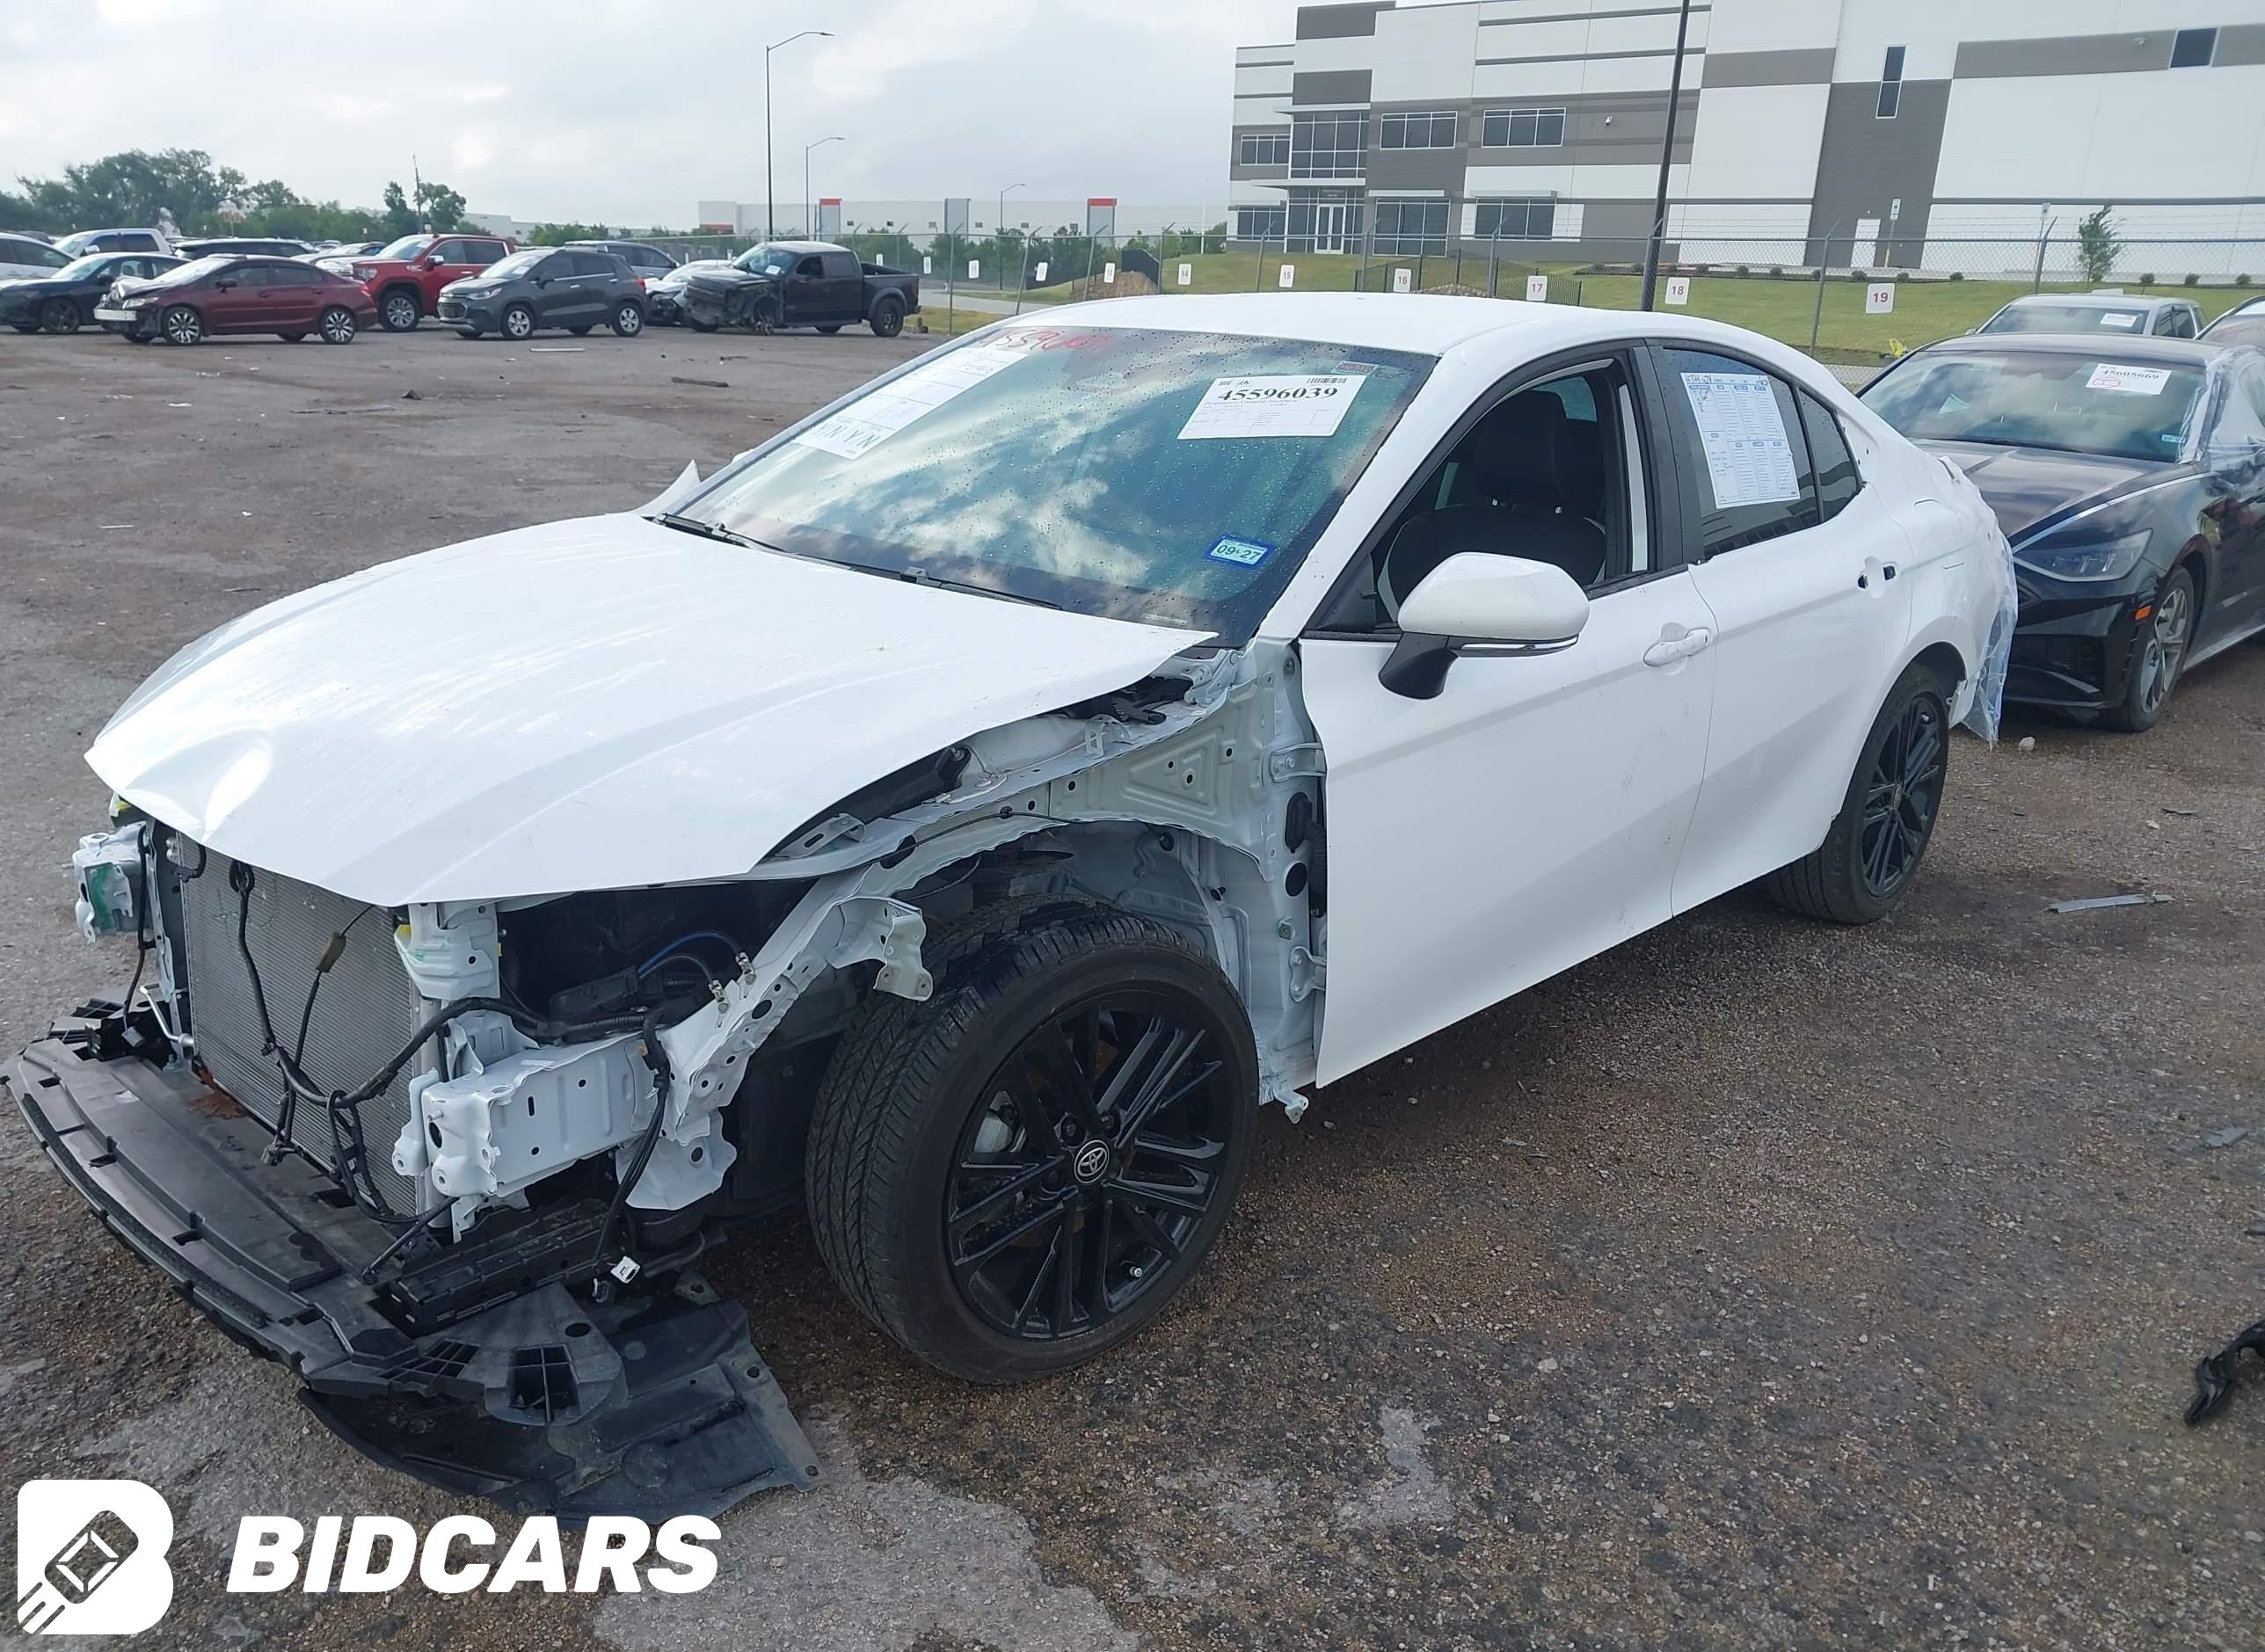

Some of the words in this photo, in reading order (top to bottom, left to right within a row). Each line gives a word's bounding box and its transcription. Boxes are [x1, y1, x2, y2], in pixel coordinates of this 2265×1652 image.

[1398, 276, 1408, 285] 16
[1532, 283, 1543, 293] 17
[1671, 286, 1684, 295] 18
[1873, 292, 1889, 303] 19
[1218, 388, 1338, 400] 45596039
